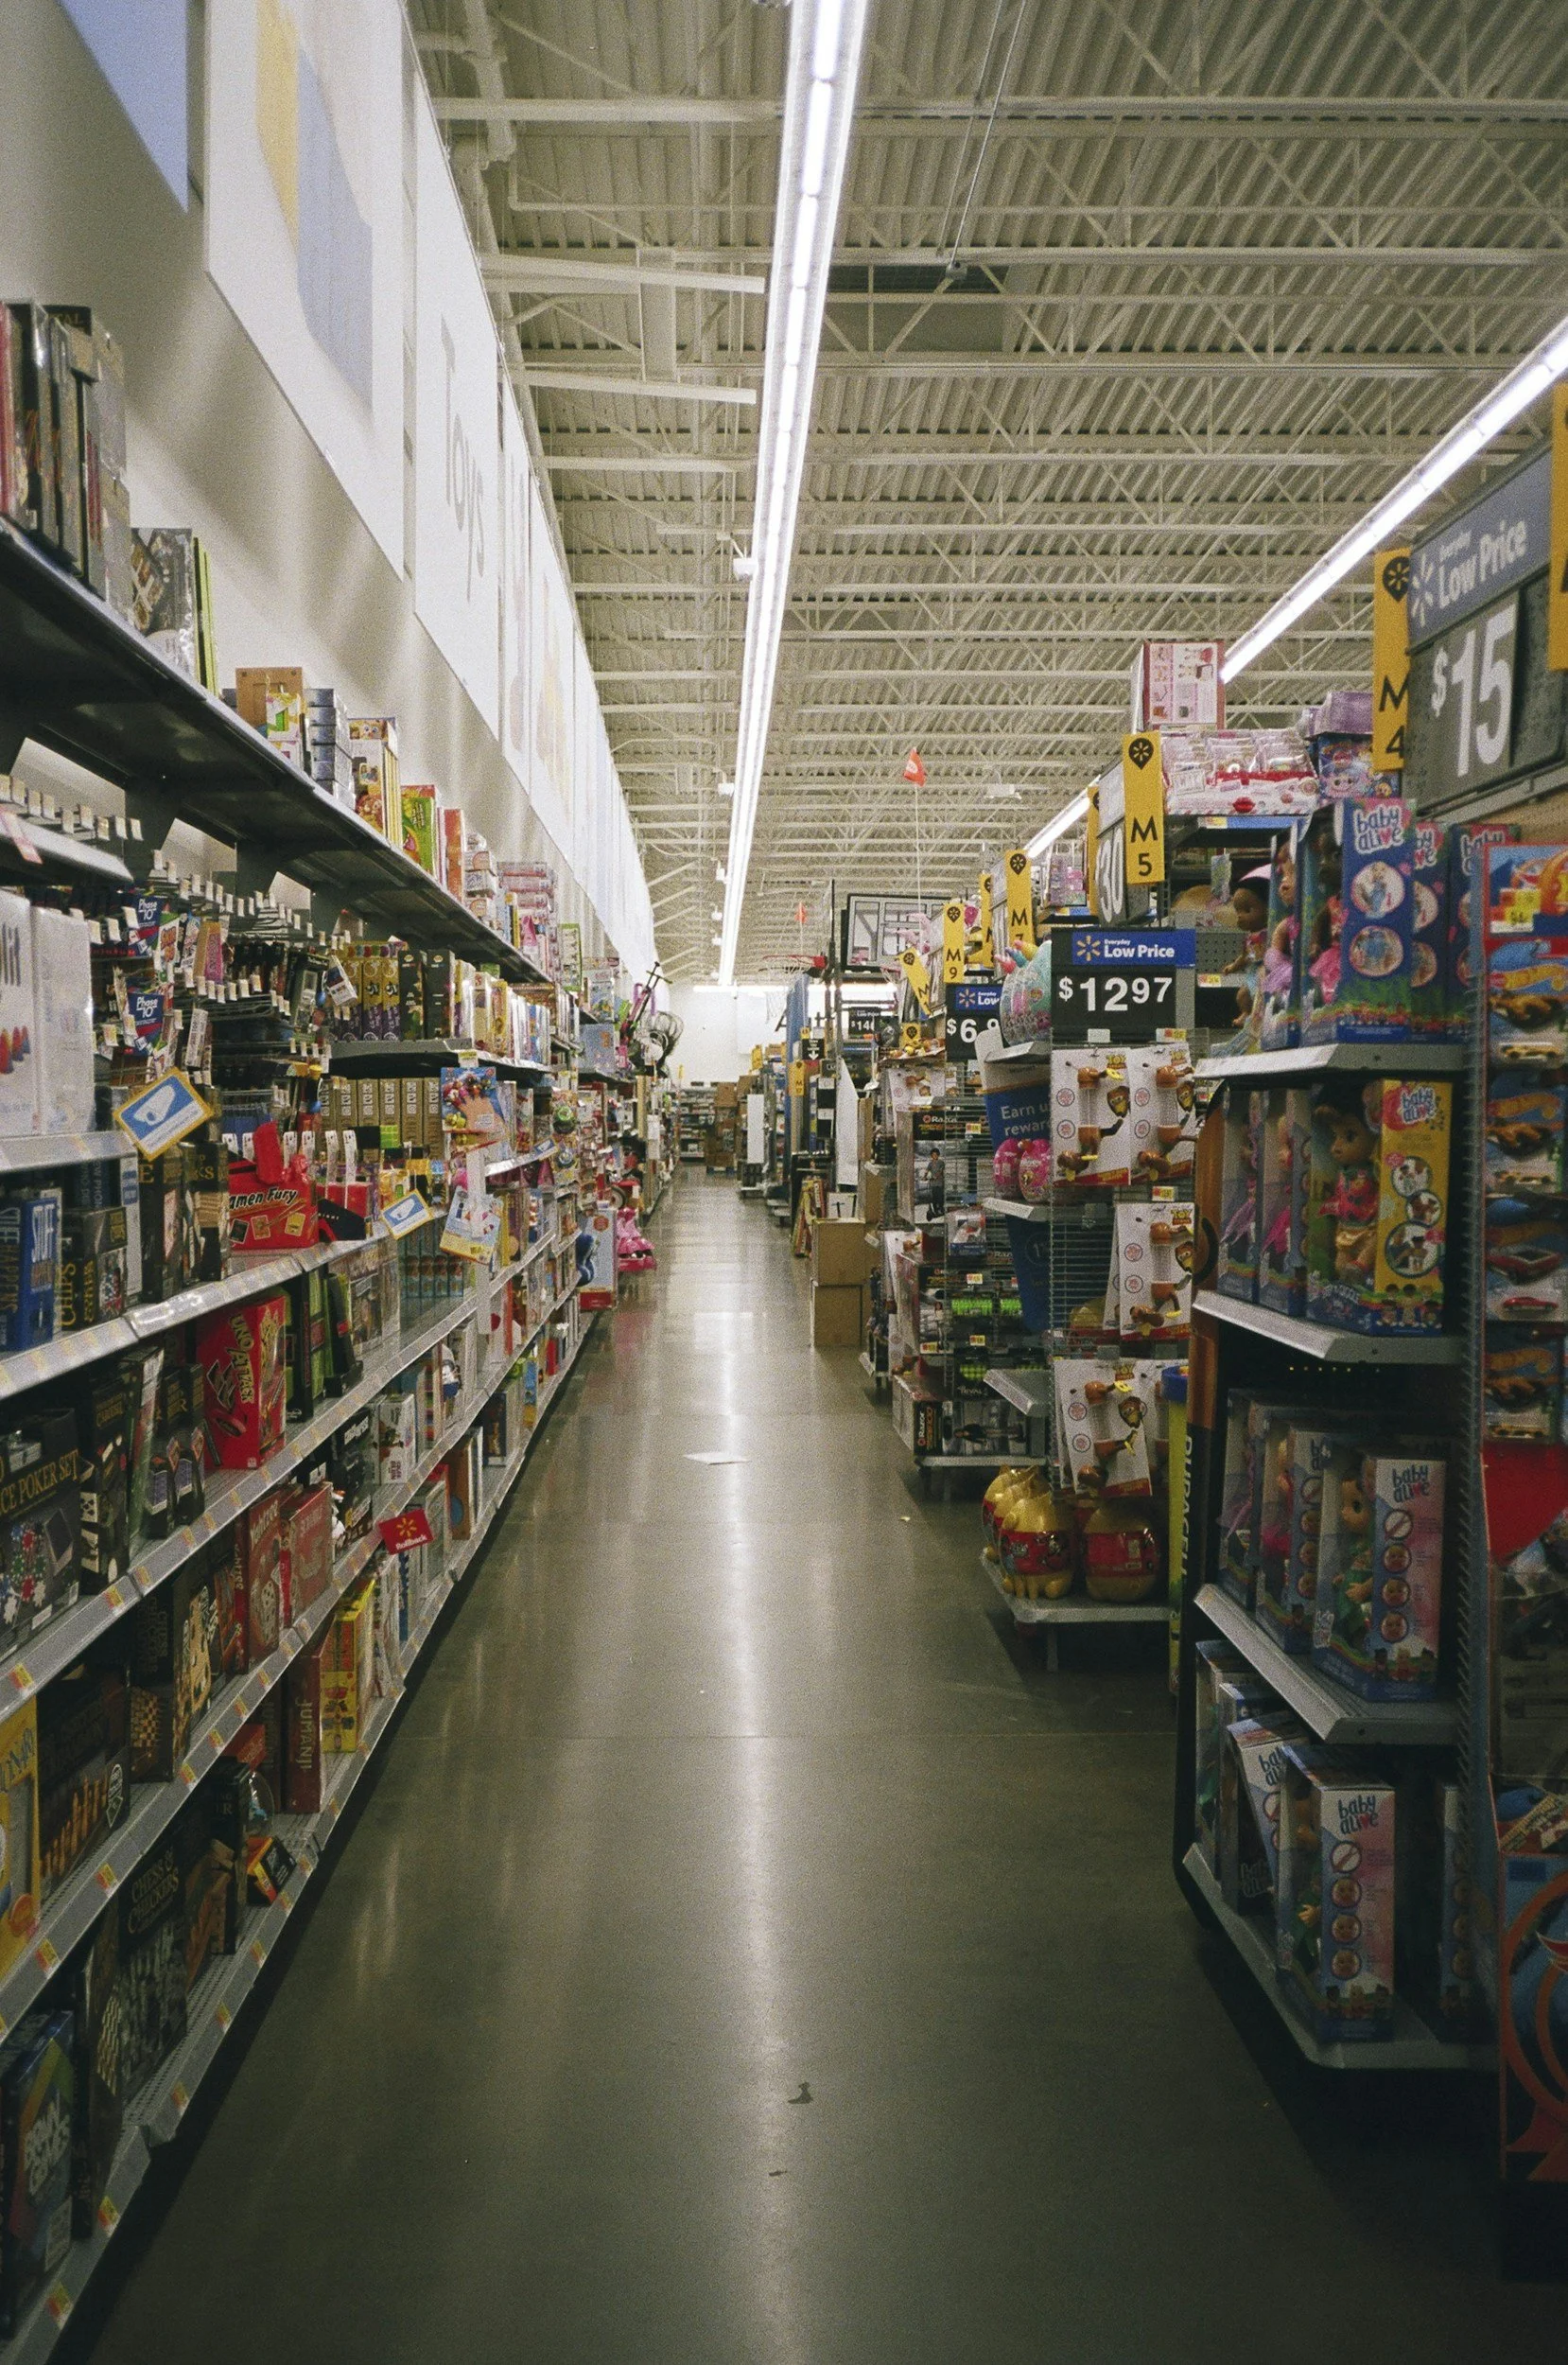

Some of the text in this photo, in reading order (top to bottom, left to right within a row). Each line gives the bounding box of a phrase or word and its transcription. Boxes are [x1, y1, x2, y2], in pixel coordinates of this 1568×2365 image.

[441, 314, 484, 603] Toys
[1438, 553, 1477, 610] Low
[1479, 519, 1527, 583] Price
[1379, 675, 1409, 712] M
[1385, 726, 1404, 759] 4
[1130, 816, 1159, 844] M
[1356, 806, 1401, 834] baby
[1138, 852, 1153, 877] 5
[138, 898, 158, 912] Phase
[143, 909, 154, 920] 10
[1011, 908, 1028, 926] M
[946, 949, 961, 962] M
[1104, 944, 1176, 958] Low Price
[949, 967, 958, 979] 9
[136, 996, 159, 1011] Phase
[141, 1007, 154, 1018] 10
[1001, 1105, 1036, 1120] Earn
[1004, 1120, 1050, 1136] rewar
[229, 1185, 298, 1211] amen Fury
[230, 1313, 254, 1351] UNO
[227, 1348, 254, 1405] ATTACK
[19, 1462, 59, 1504] POKER
[59, 1448, 79, 1481] SET
[1392, 1463, 1430, 1488] baby
[295, 1697, 312, 1770] JUMANJI
[1338, 1795, 1377, 1819] baby
